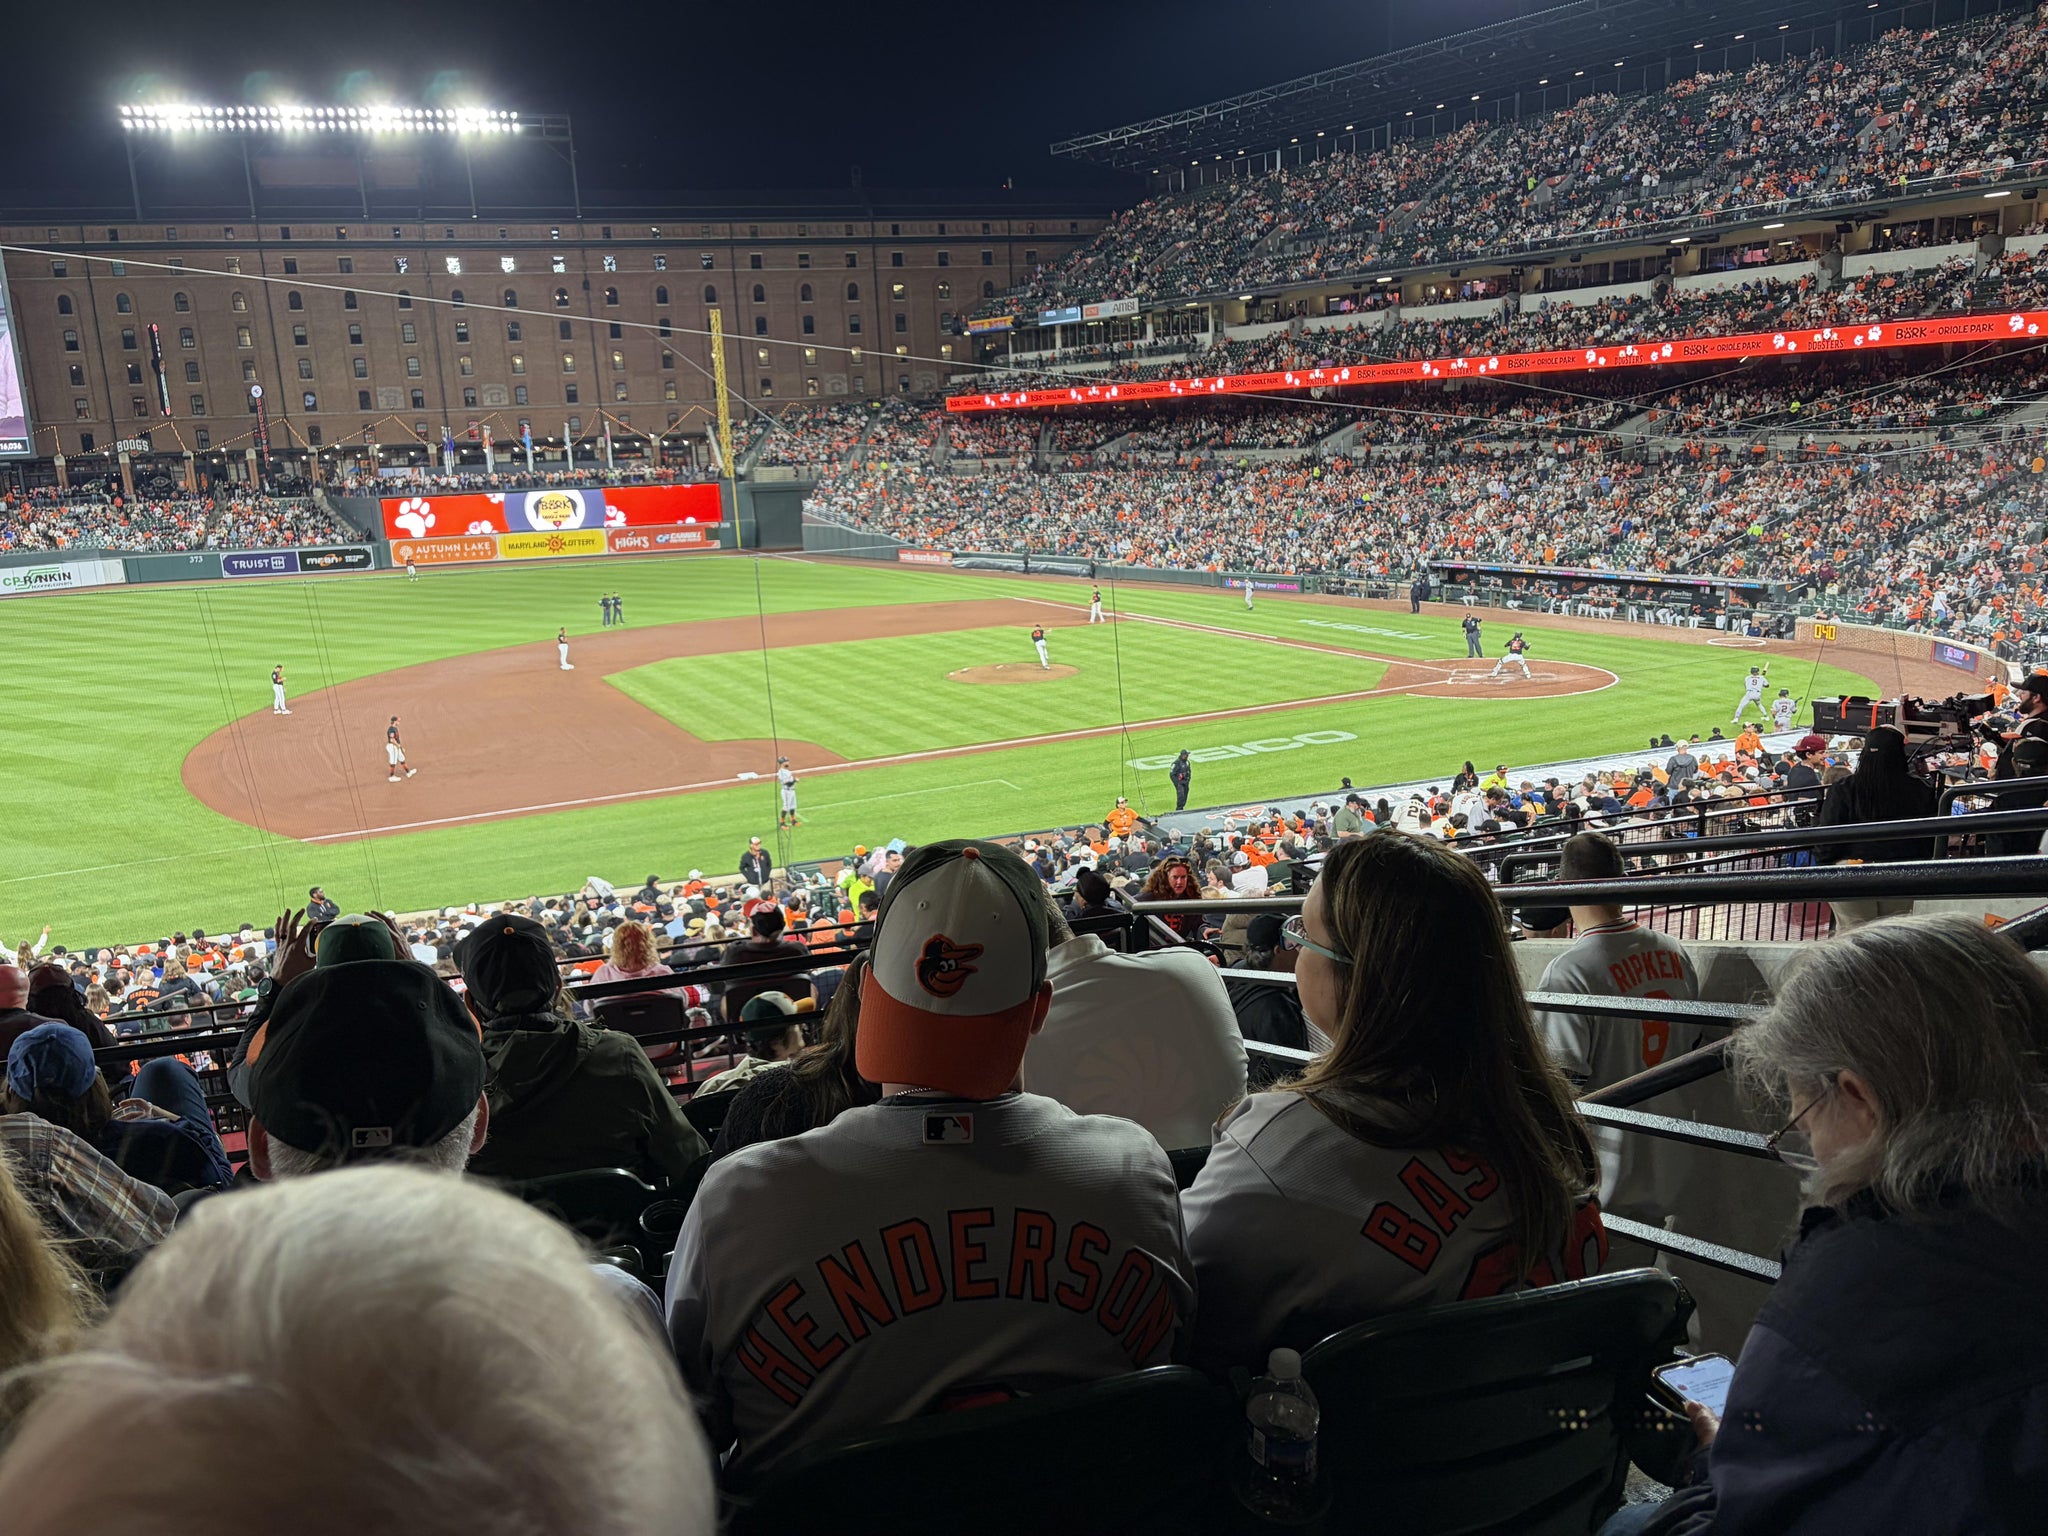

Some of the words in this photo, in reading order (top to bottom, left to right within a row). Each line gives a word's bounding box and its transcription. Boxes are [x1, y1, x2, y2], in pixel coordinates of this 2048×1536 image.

[1938, 326, 1967, 335] ORIOLE
[1970, 323, 1994, 333] PARK
[1717, 343, 1741, 351] ORIOLE
[1742, 341, 1761, 350] PARK
[1807, 339, 1844, 350] DOGSTERS
[1559, 356, 1576, 364] PARK
[416, 544, 461, 554] AUTUMN
[464, 541, 491, 551] LAKE
[508, 541, 547, 550] MARYLAND
[564, 539, 596, 547] LOTTERY
[615, 536, 649, 549] HIGH'S
[232, 559, 269, 569] TRUIST
[23, 572, 72, 585] RANKIN
[1126, 730, 1358, 770] GEICO
[1608, 949, 1684, 993] RIPKEN
[736, 1206, 1176, 1409] HENDERSON
